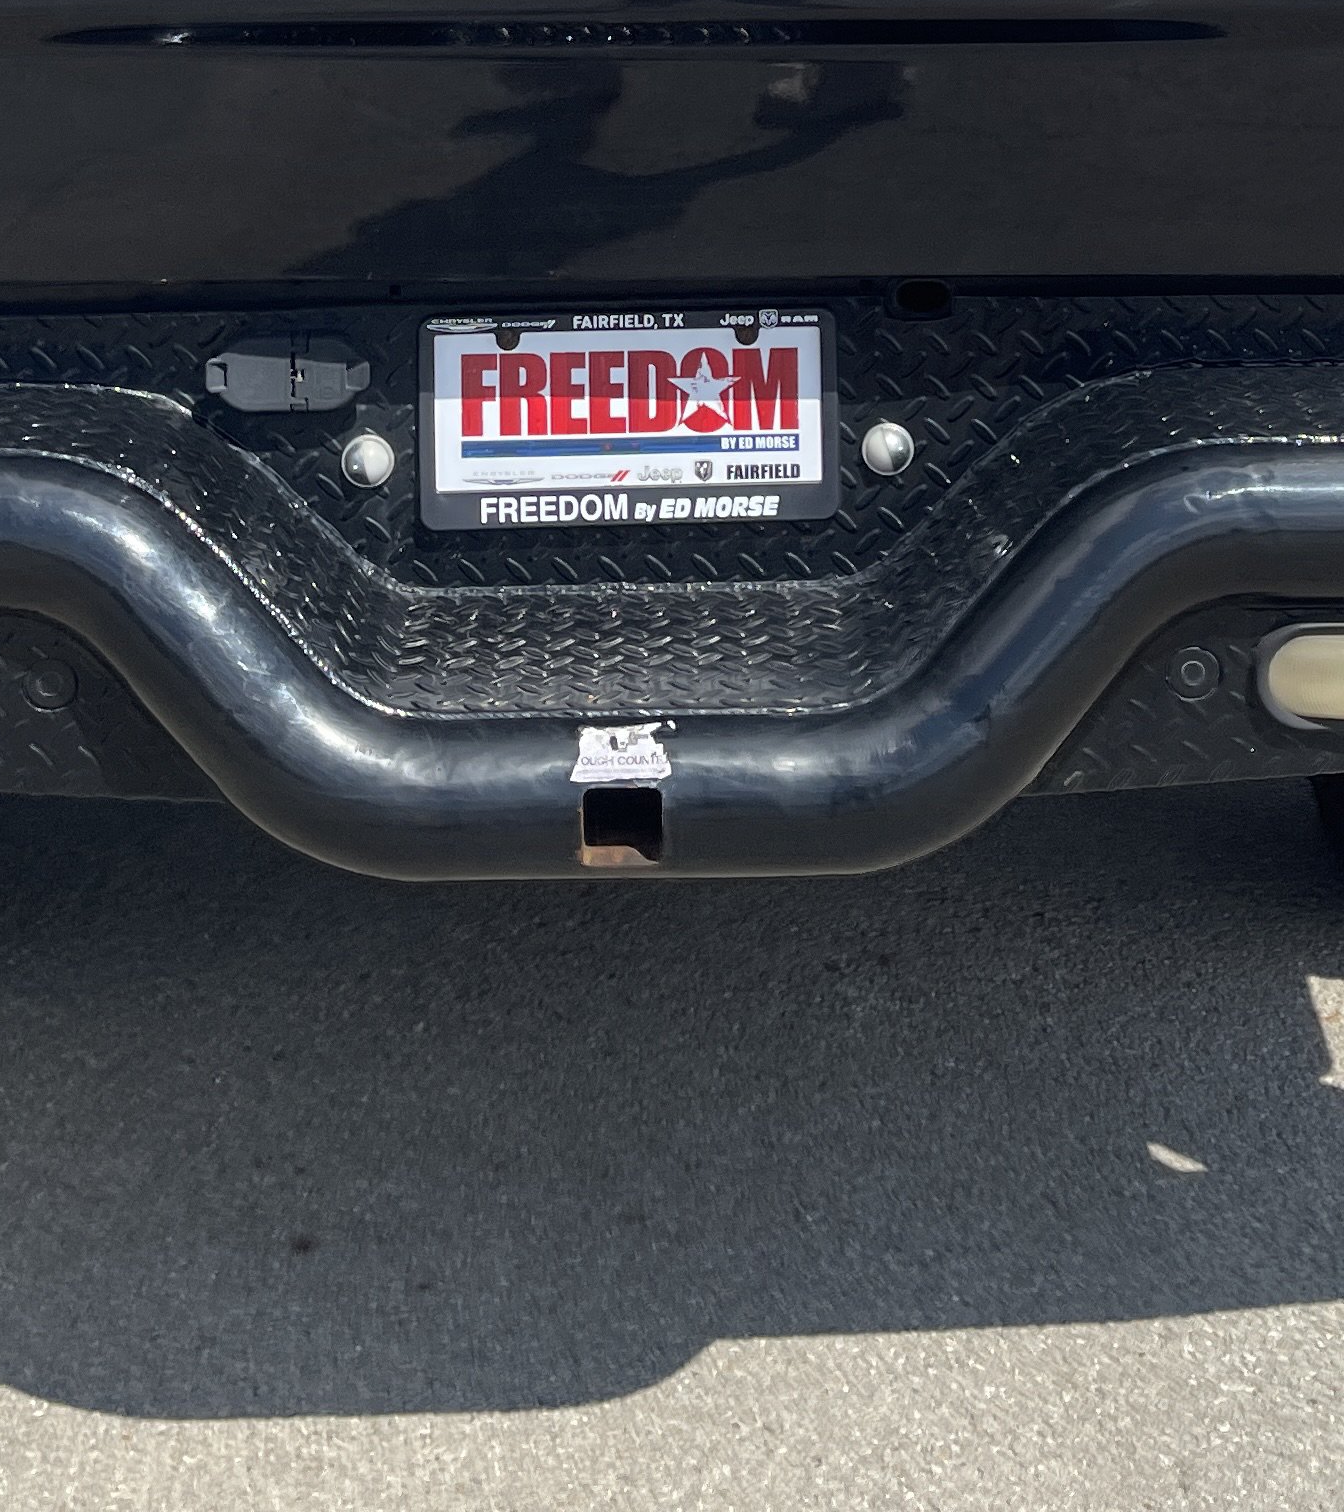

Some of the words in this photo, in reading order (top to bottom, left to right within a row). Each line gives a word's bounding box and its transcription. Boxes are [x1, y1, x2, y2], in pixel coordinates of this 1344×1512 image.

[572, 314, 658, 330] FAIRFIELD,
[661, 313, 685, 328] TX
[720, 313, 755, 327] Jeep
[780, 314, 819, 324] RAM
[461, 347, 800, 437] FREEDOM
[720, 437, 737, 450] BY
[738, 436, 753, 450] ED
[755, 436, 796, 450] MORSE
[637, 465, 683, 484] Jeep
[726, 463, 801, 480] FAIRFIELD
[480, 493, 628, 525] FREEDOM
[634, 502, 657, 522] By
[659, 498, 692, 519] ED
[693, 495, 780, 519] MORSE
